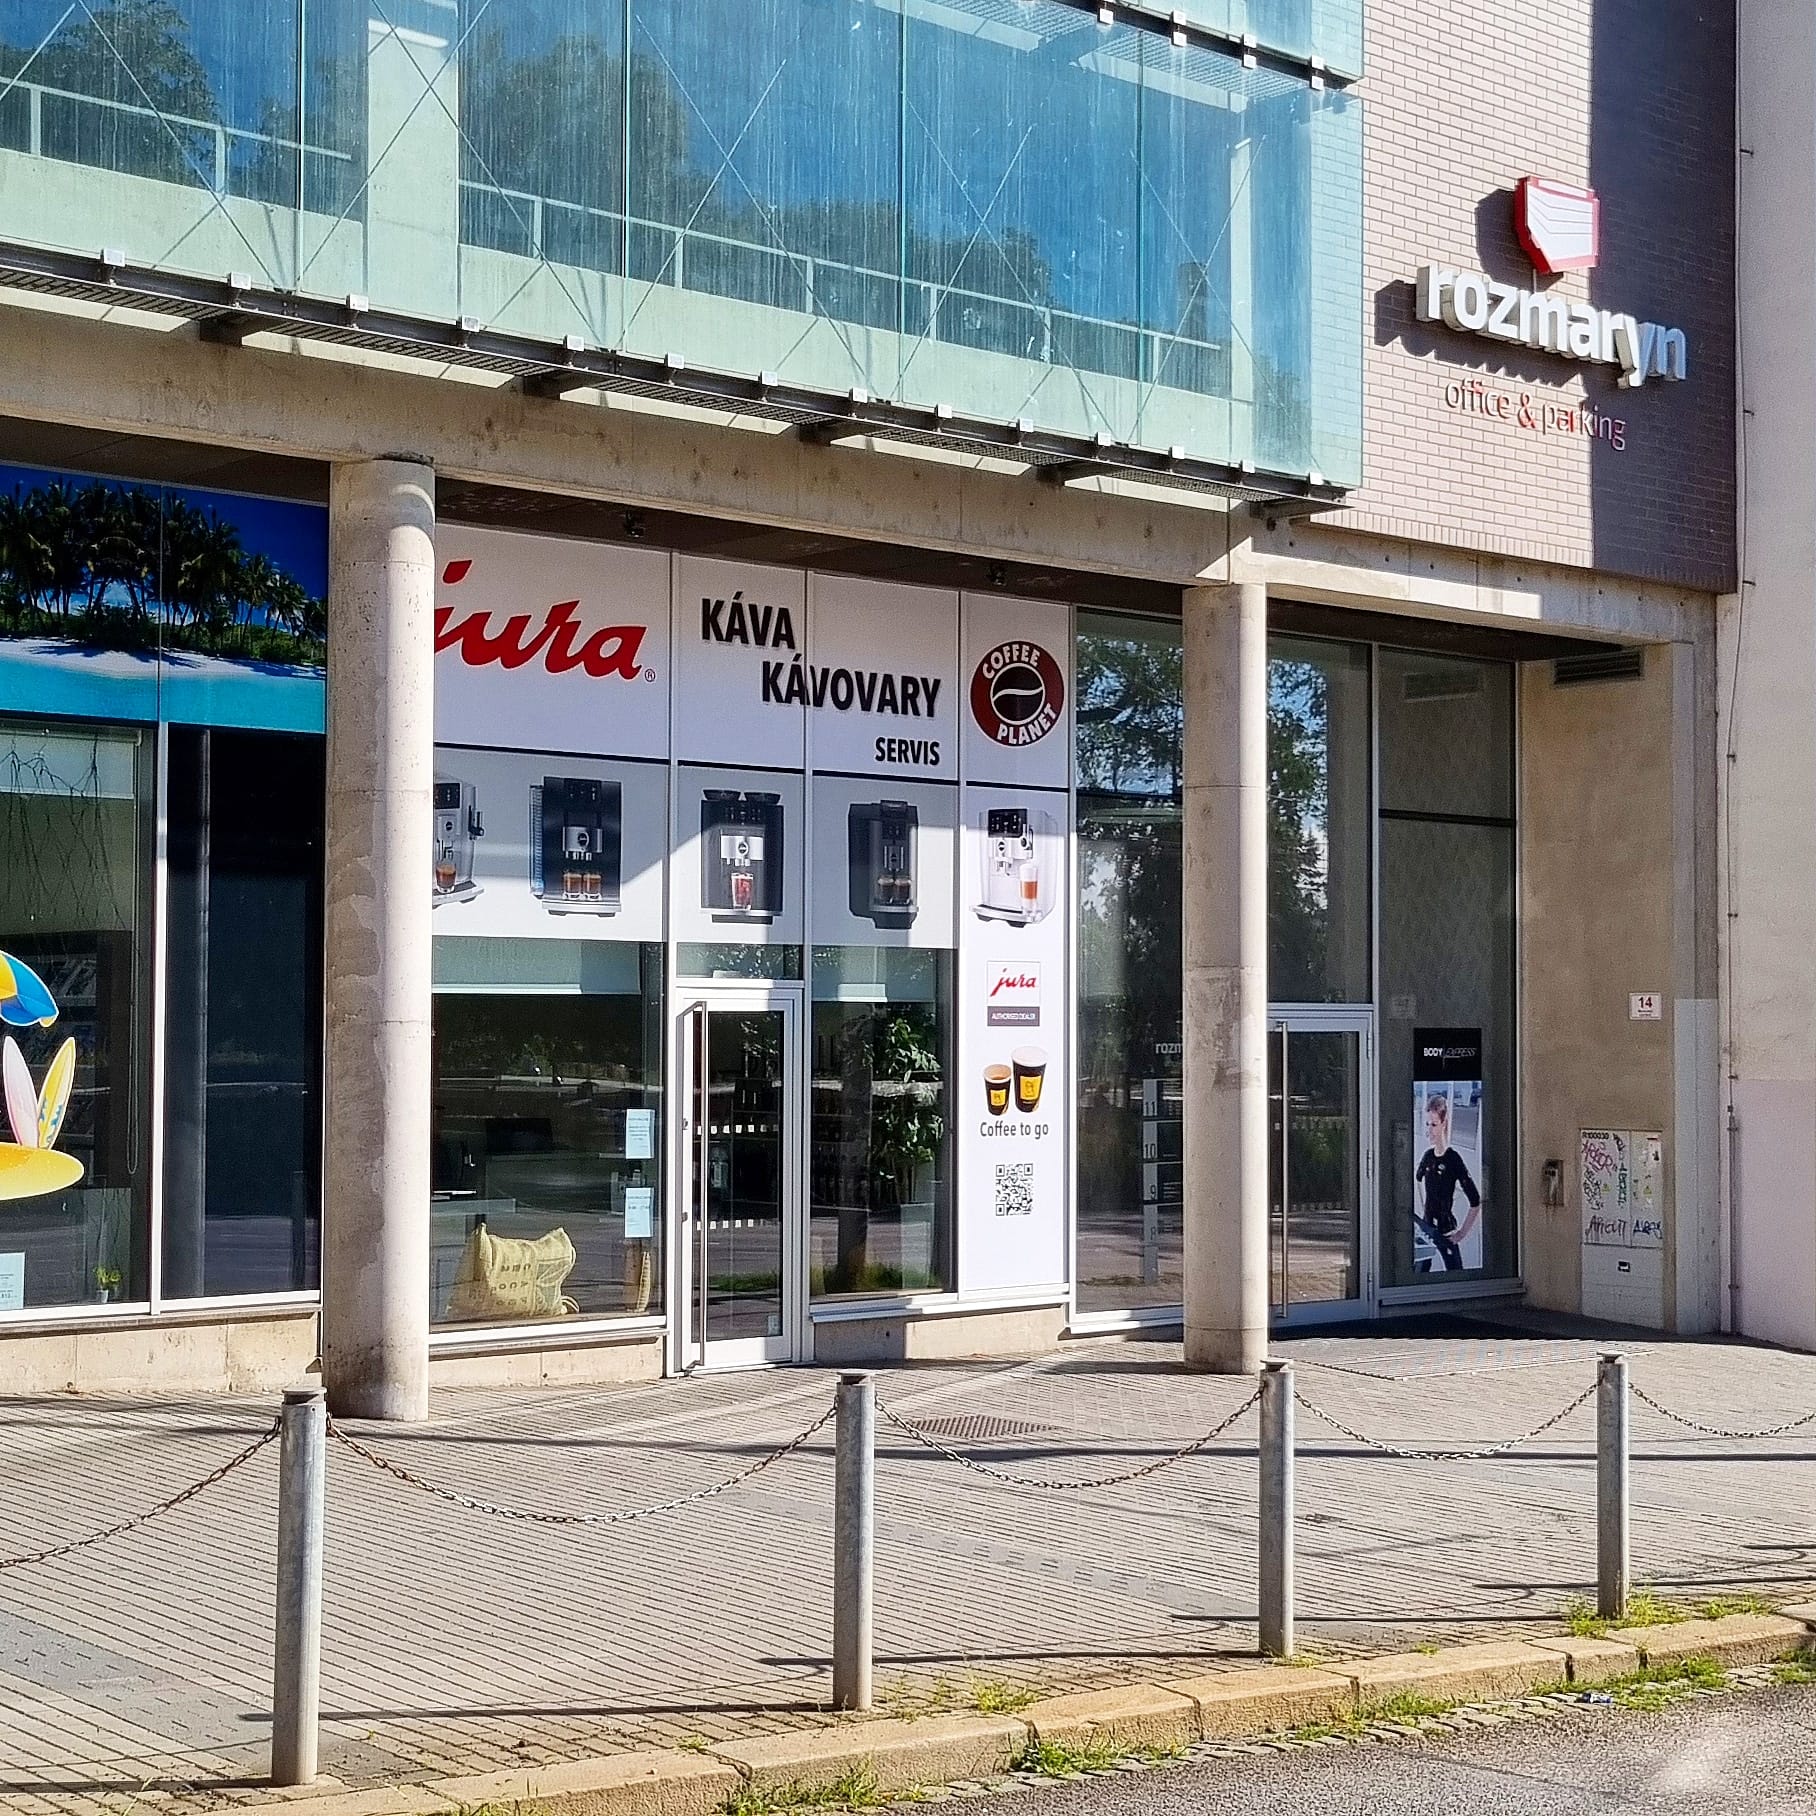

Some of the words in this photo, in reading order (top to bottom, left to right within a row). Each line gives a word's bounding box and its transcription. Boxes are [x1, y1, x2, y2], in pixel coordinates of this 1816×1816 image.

[1416, 262, 1687, 389] rozmaryn
[1445, 378, 1510, 419] office
[1516, 392, 1537, 430] &
[1542, 398, 1626, 451] parking
[702, 591, 795, 650] KÁVA
[980, 641, 1040, 679] COFFEE
[762, 653, 941, 718] KÁVOVARY
[997, 701, 1056, 746] PLANET
[875, 736, 941, 766] SERVIS
[989, 967, 1037, 998] jura
[1638, 996, 1653, 1009] 14
[1423, 1047, 1443, 1057] BODY
[980, 1121, 1017, 1138] Coffee
[1020, 1122, 1032, 1137] to
[1035, 1124, 1049, 1139] go
